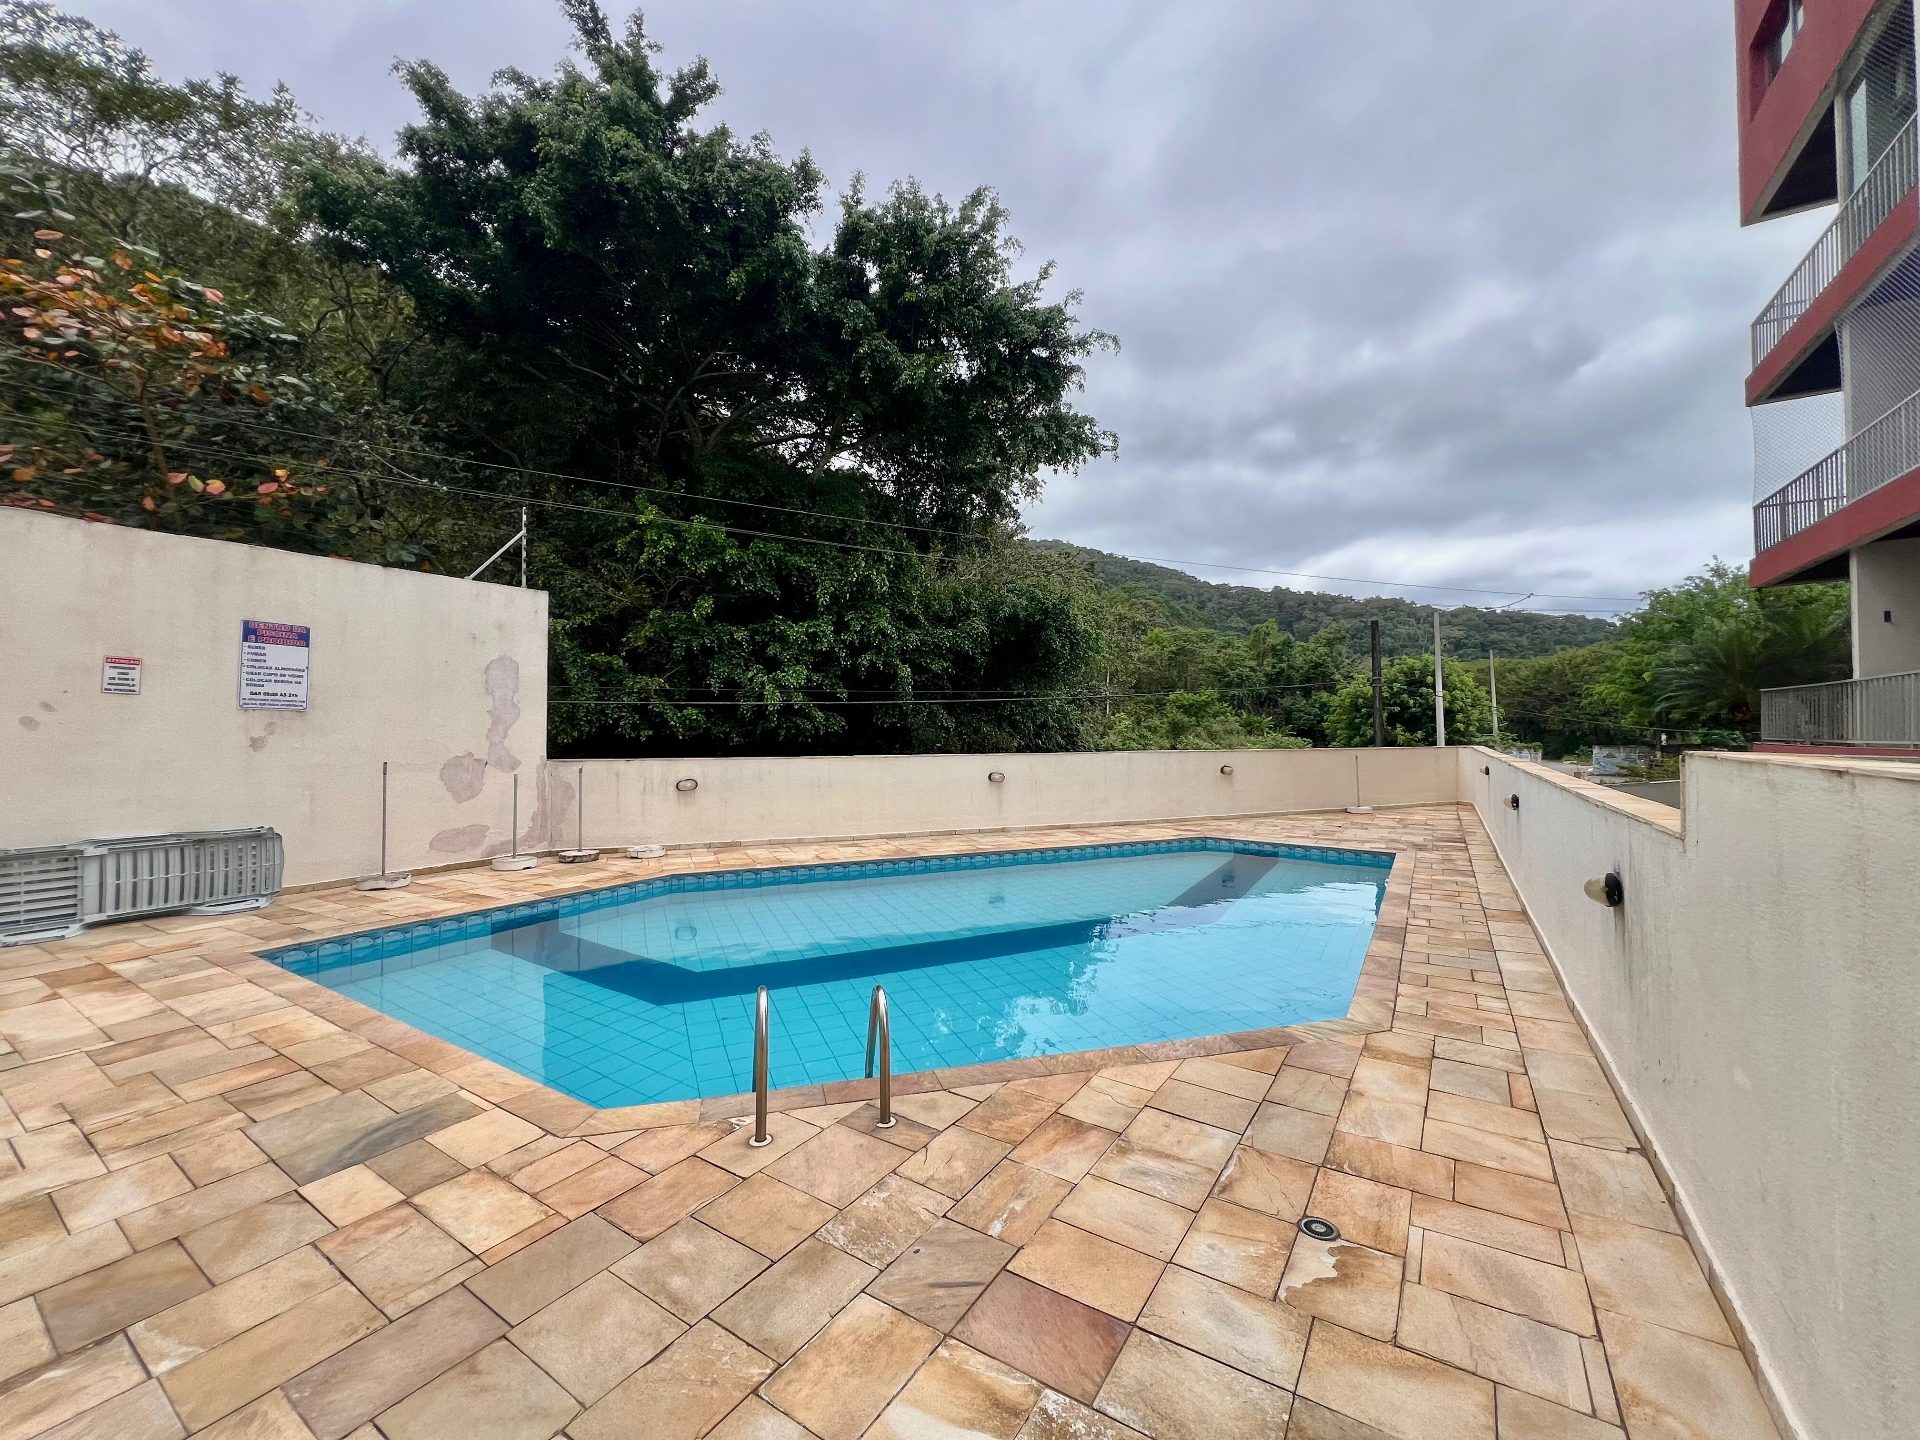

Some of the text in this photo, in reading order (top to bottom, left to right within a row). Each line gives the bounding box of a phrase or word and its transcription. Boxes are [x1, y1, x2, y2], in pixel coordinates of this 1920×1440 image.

[249, 621, 290, 631] DENTRO
[257, 629, 298, 639] PISCINA
[258, 636, 305, 646] PROIBIDO
